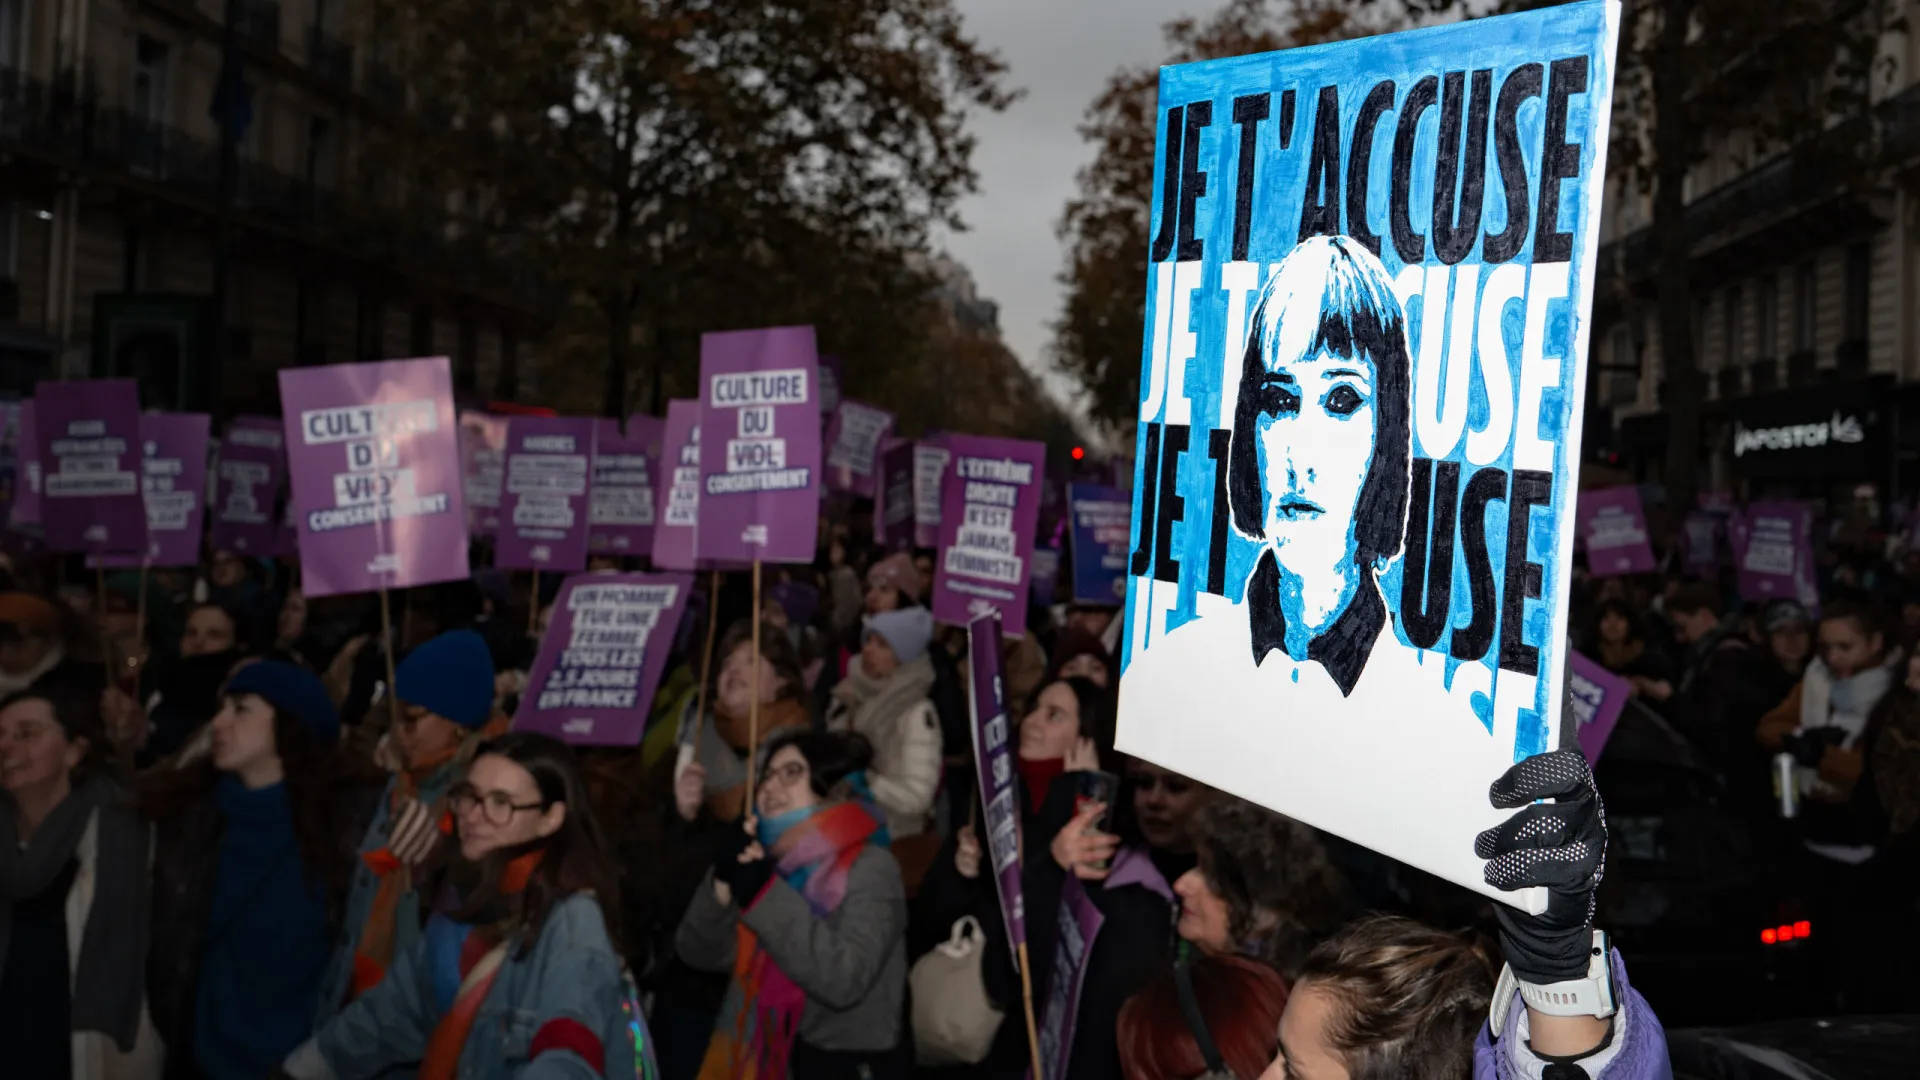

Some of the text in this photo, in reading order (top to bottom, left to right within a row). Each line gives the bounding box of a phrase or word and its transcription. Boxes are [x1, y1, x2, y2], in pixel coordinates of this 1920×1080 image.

[1152, 55, 1589, 265] JE T'ACCUSE
[1141, 260, 1203, 425] JE
[714, 376, 802, 401] CULTURE
[309, 404, 431, 438] CULT
[743, 411, 768, 433] DU
[354, 443, 393, 467] D
[734, 444, 778, 468] VIOL
[345, 474, 405, 499] VIO
[706, 468, 810, 495] CONSENTEMENT
[965, 481, 1018, 507] DROITE
[1132, 423, 1190, 583] JE
[969, 508, 1007, 527] N'EST
[961, 532, 1010, 555] JAMAIS
[573, 588, 668, 604] UN HOMME
[581, 608, 651, 625] TUE UNE
[575, 629, 640, 645] FEMME
[561, 648, 645, 669] TOUS LES
[577, 669, 640, 689] JOURS
[538, 689, 638, 711] EN FRANCE
